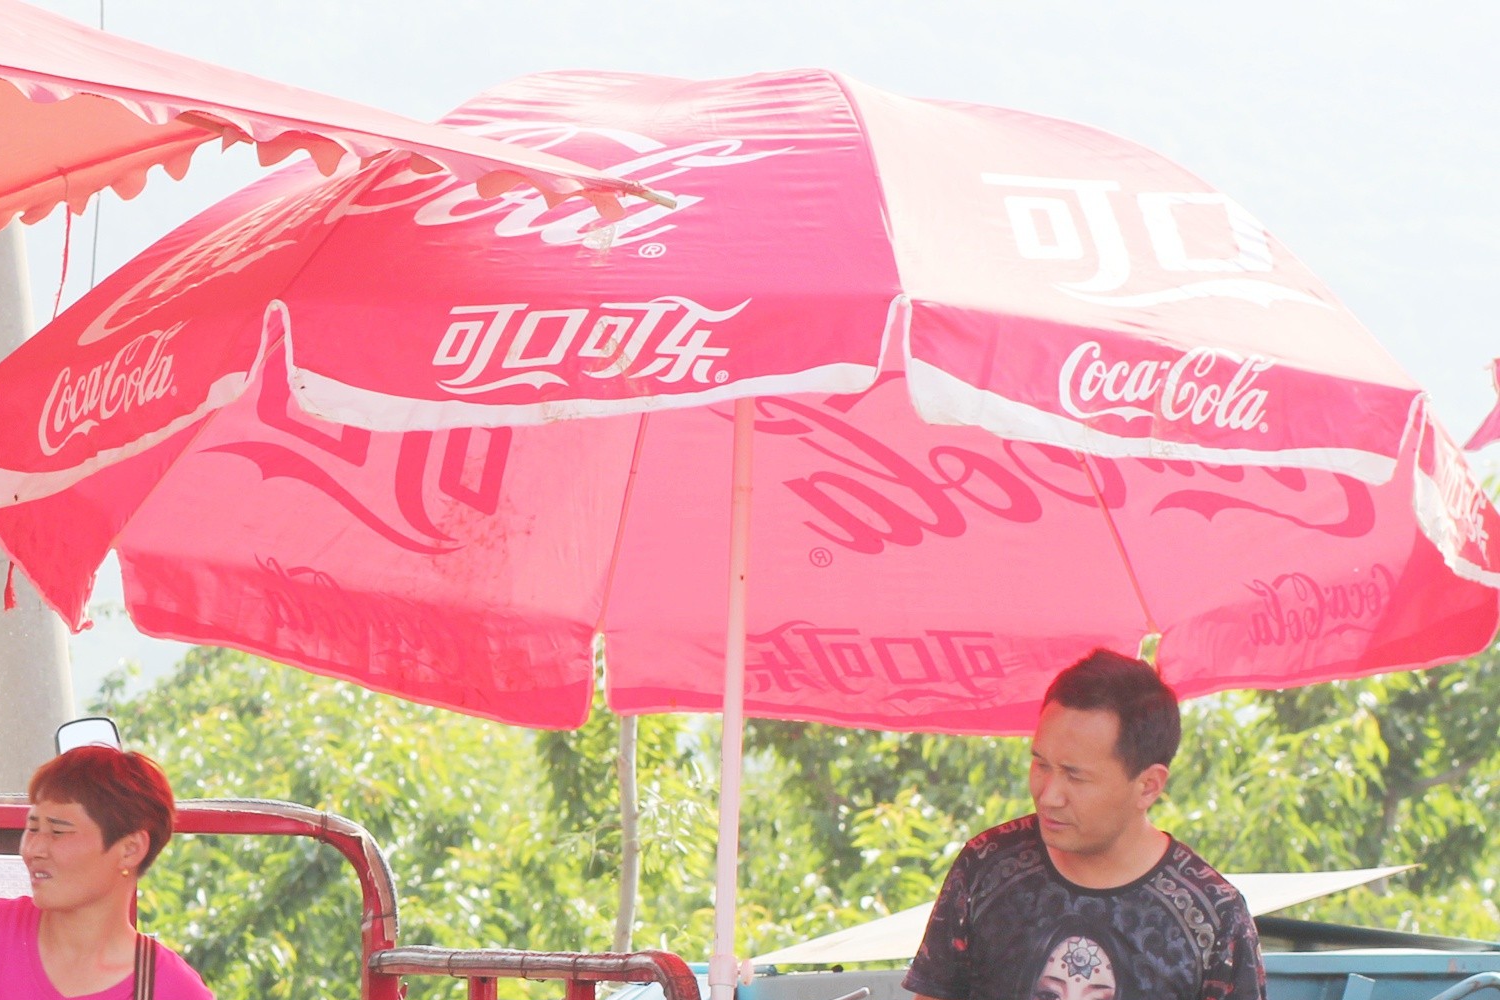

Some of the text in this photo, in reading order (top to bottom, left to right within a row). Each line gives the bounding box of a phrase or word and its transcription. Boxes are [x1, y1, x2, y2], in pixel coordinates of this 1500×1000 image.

[38, 319, 192, 456] Coca-Cola
[433, 296, 752, 395] 可口可乐
[1059, 341, 1276, 432] Coca-Cola
